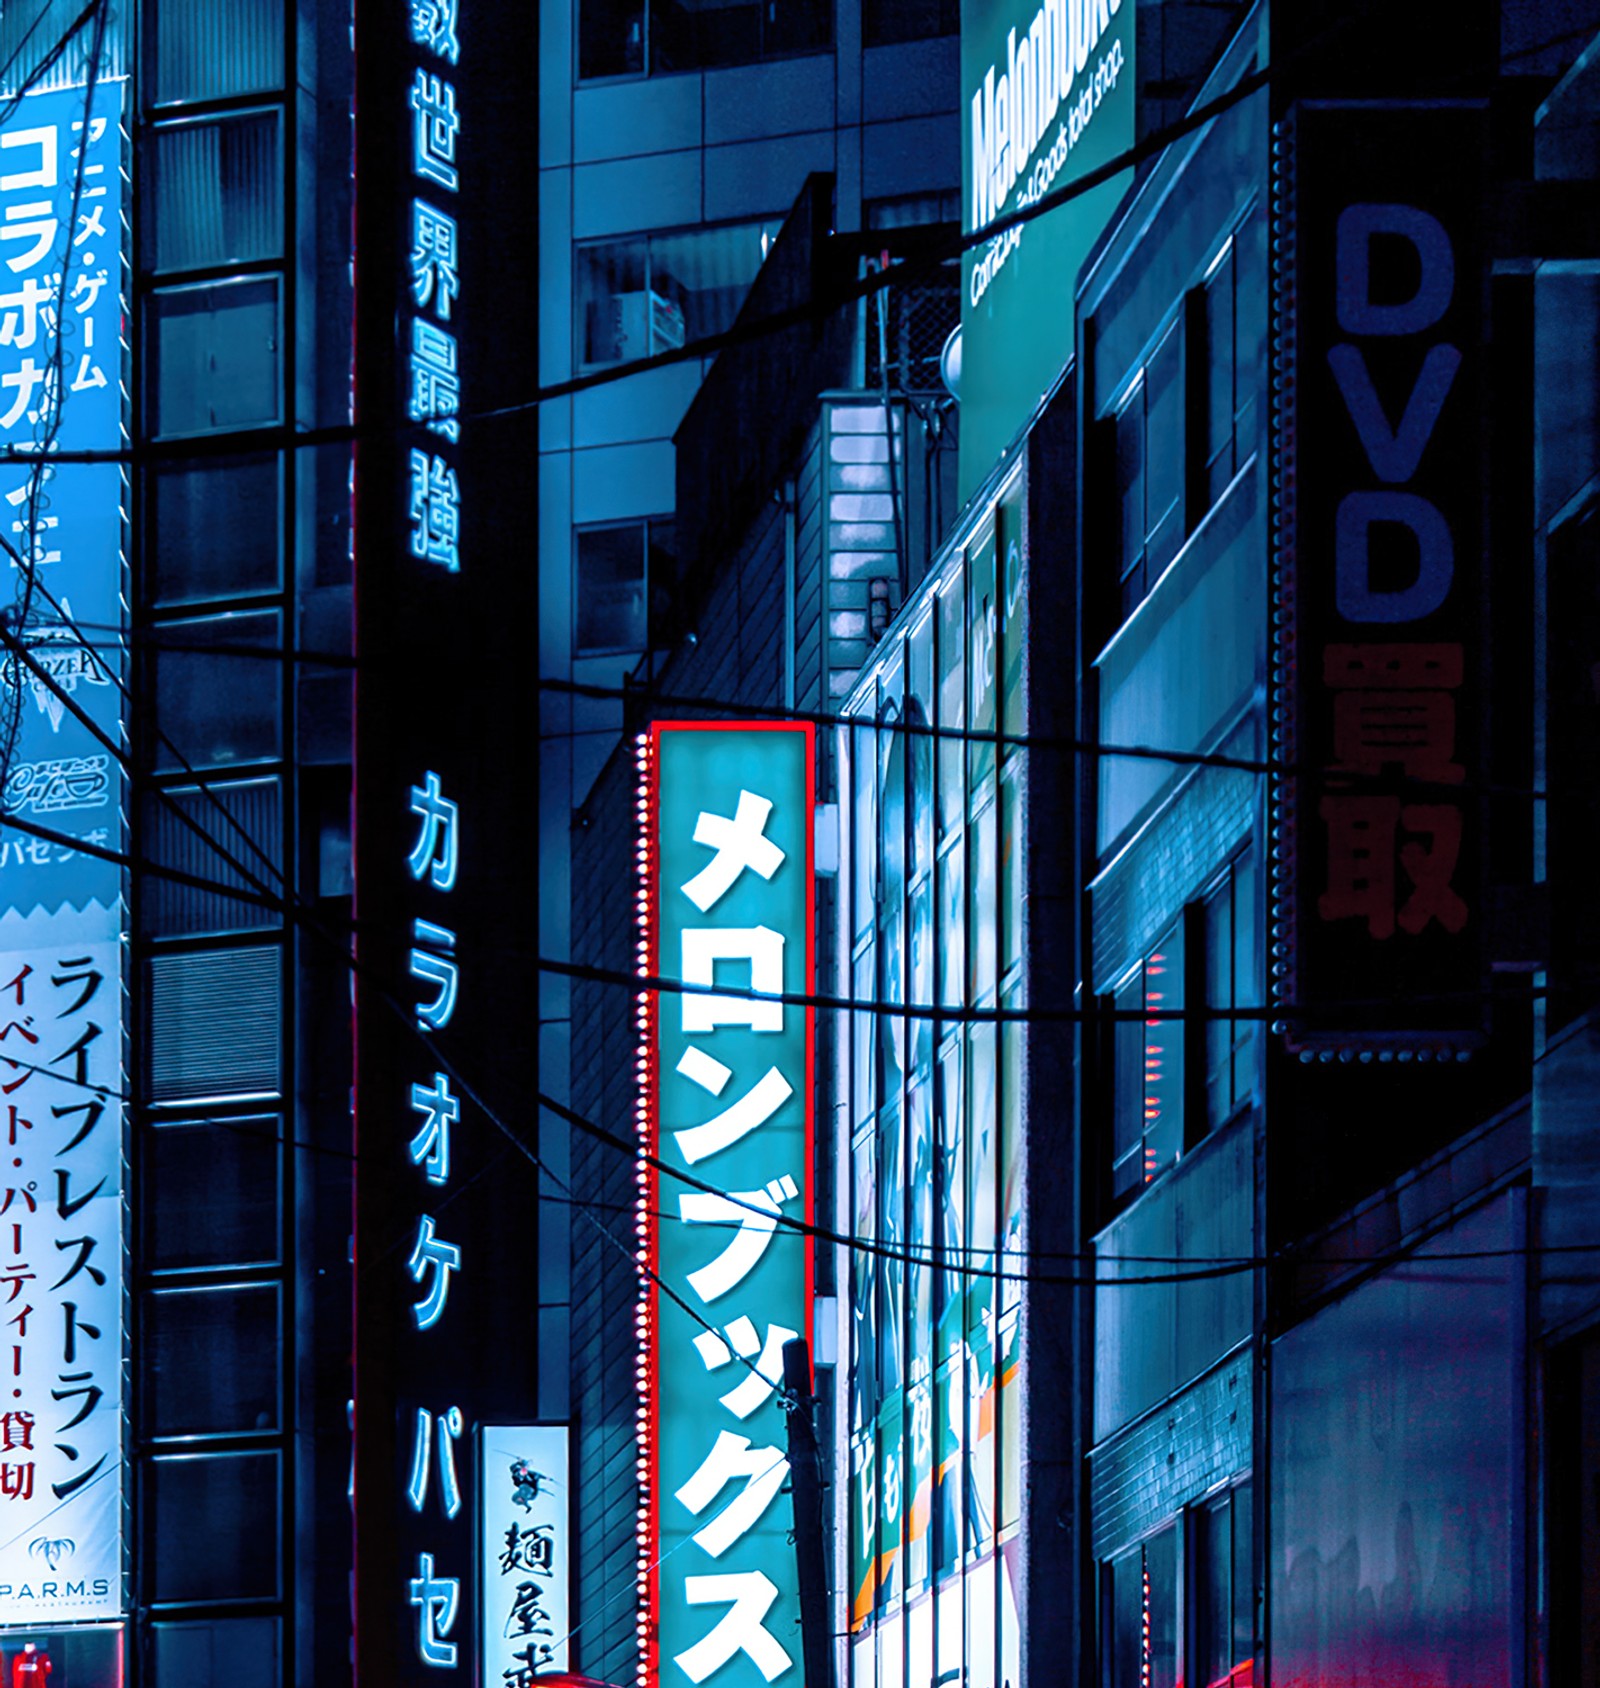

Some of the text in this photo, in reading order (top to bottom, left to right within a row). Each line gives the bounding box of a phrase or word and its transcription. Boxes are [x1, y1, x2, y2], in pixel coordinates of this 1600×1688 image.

[972, 0, 1121, 247] Melonboo
[1318, 202, 1468, 939] DVD買取
[0, 964, 40, 1500] イベント・パーティー・貸切
[48, 956, 108, 1500] ライブレストラン
[408, 771, 461, 1329] カラオケ
[673, 789, 800, 1685] メロンブックス
